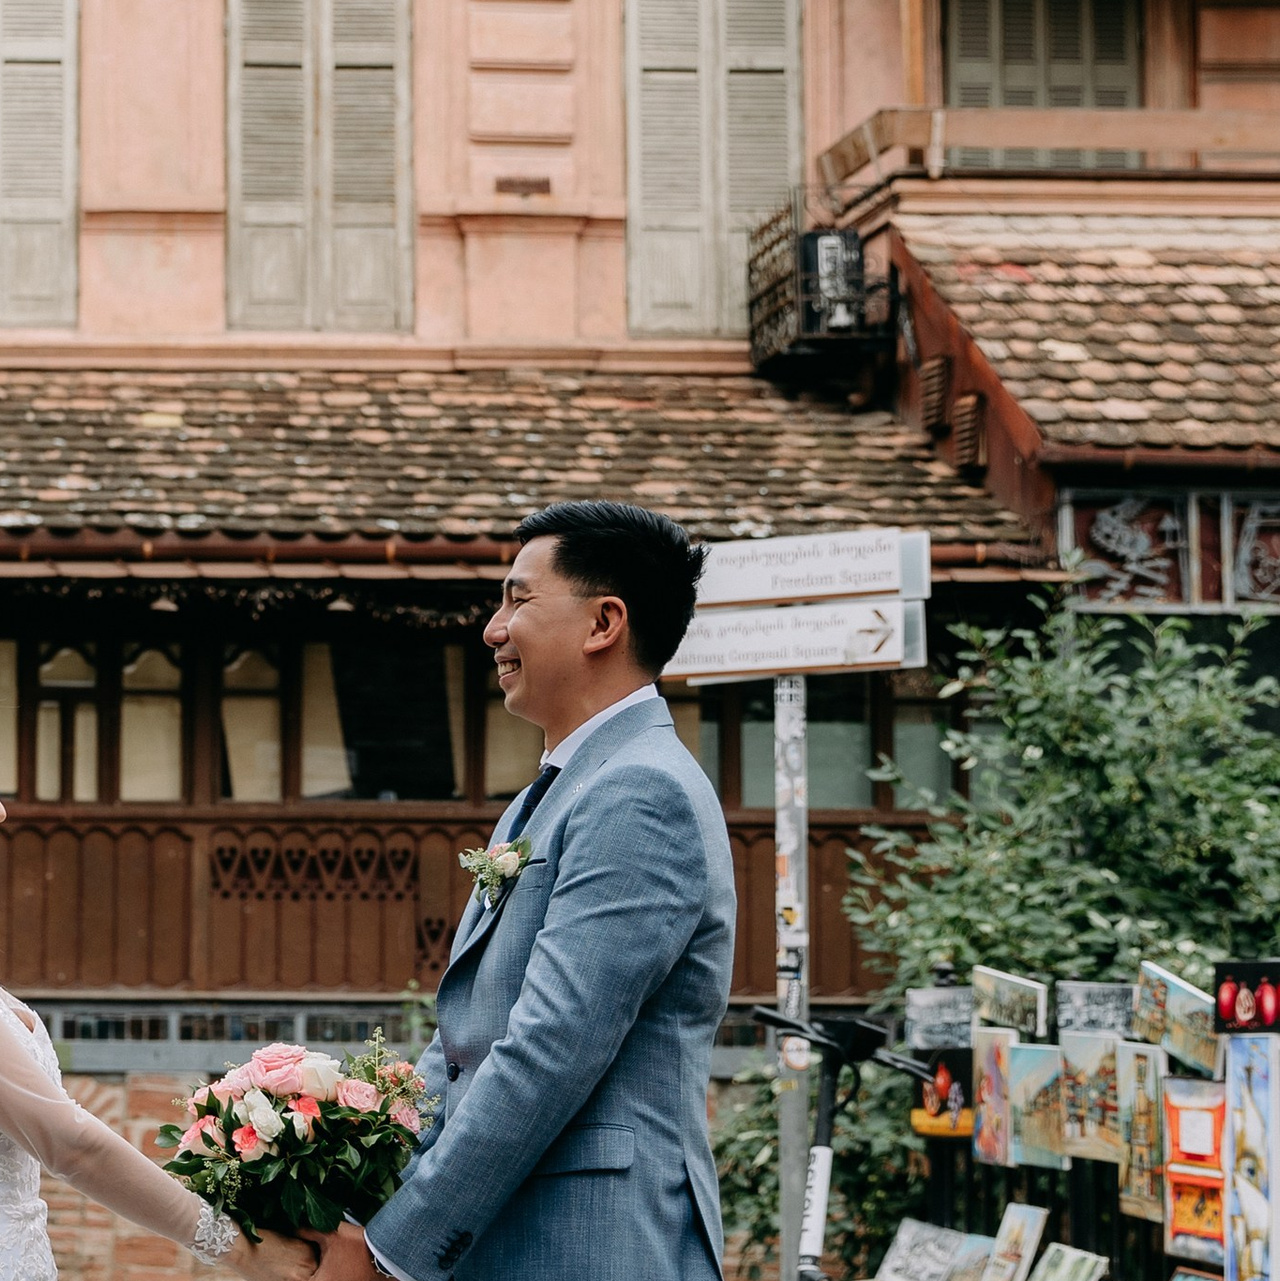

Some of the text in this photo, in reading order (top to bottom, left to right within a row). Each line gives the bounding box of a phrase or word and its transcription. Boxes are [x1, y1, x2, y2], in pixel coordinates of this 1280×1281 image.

[771, 569, 893, 590] Freedom Square
[793, 645, 838, 660] Square
